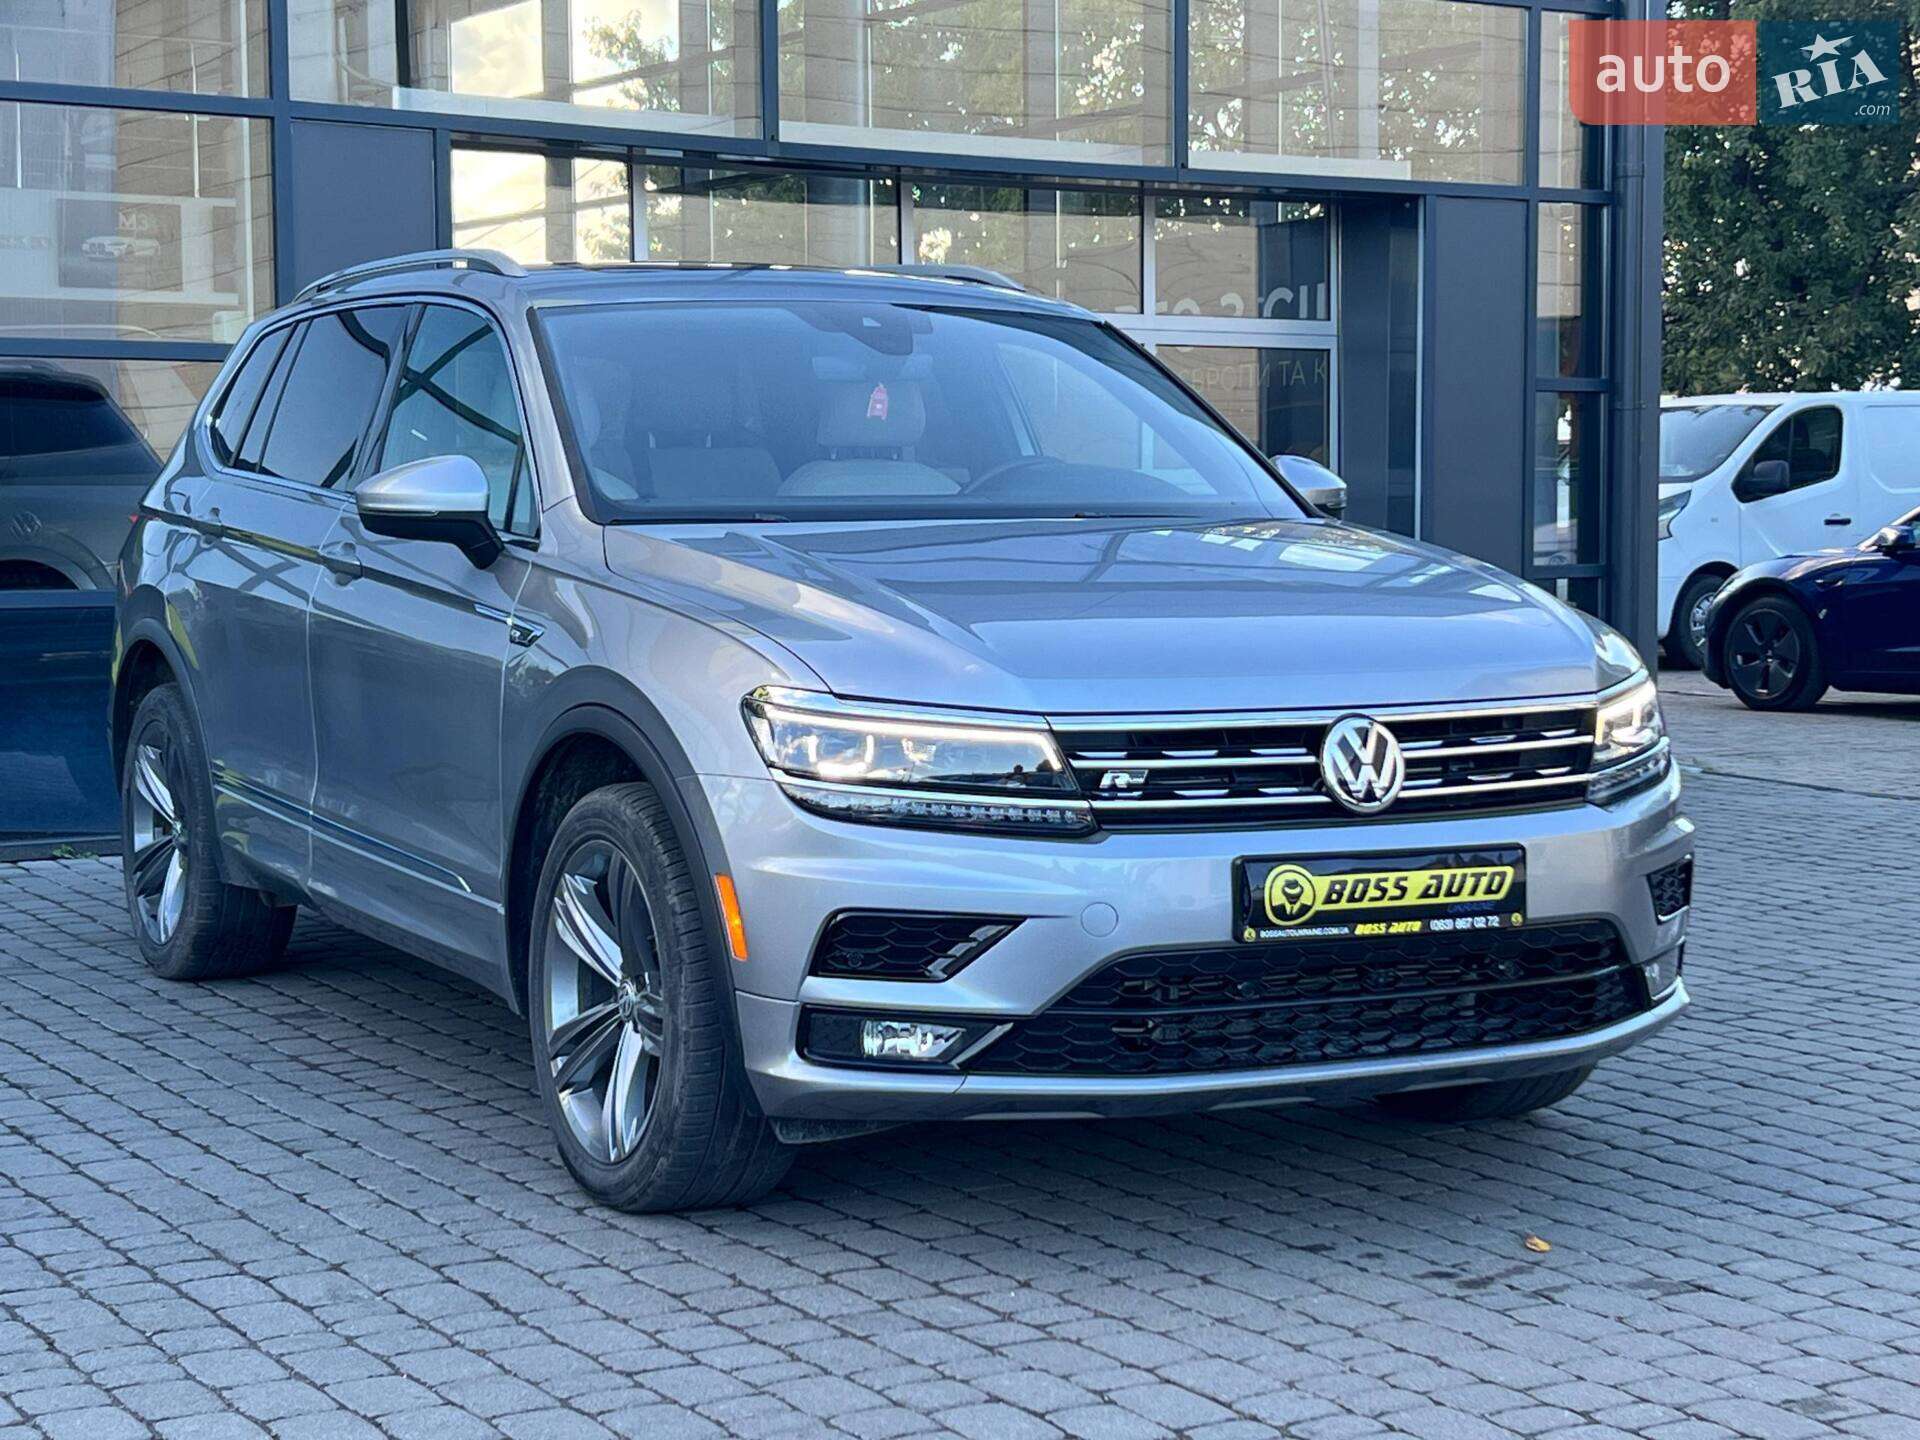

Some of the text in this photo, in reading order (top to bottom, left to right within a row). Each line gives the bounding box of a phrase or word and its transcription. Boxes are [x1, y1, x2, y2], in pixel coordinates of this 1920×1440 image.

[1322, 871, 1507, 905] BOSS AUTO
[1354, 920, 1422, 935] BOSS AUTO
